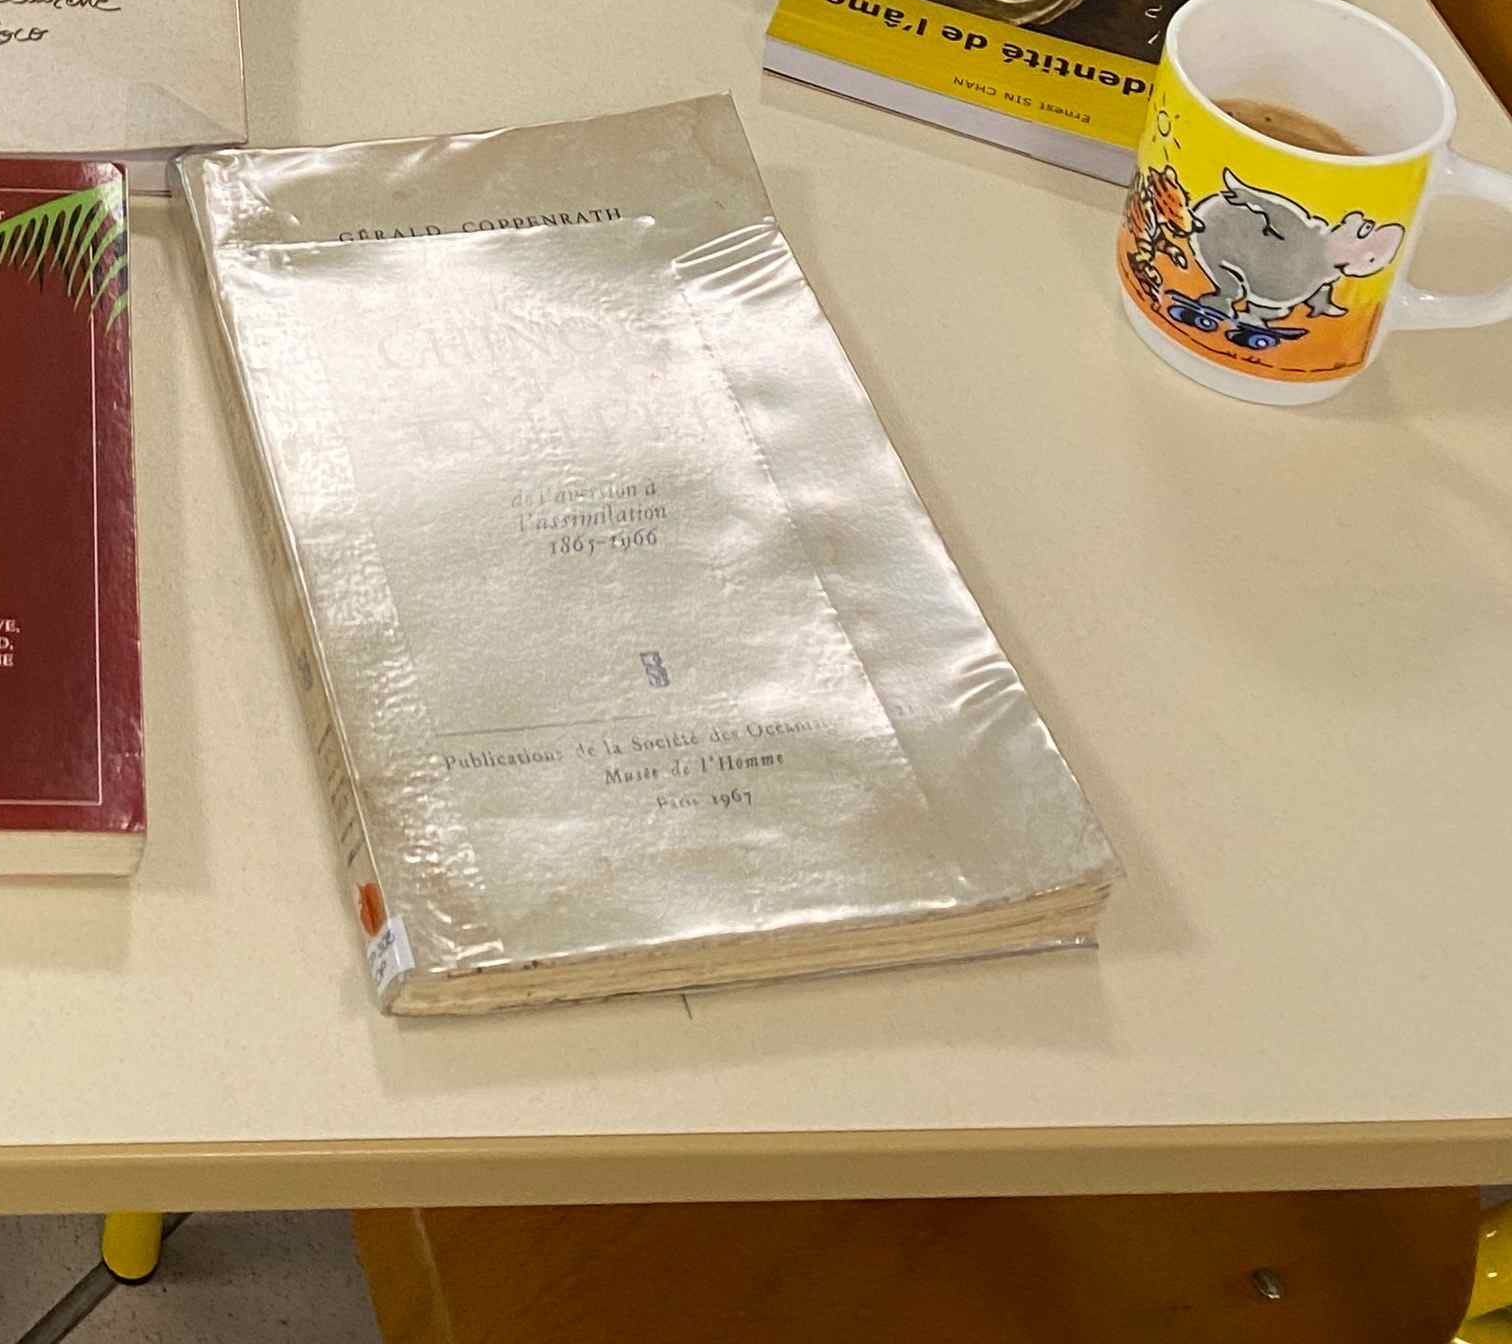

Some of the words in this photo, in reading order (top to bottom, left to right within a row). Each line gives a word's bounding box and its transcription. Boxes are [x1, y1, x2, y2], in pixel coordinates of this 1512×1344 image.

[940, 23, 988, 50] de
[953, 76, 998, 98] CHAN
[1005, 91, 1033, 106] SIN
[1039, 103, 1092, 125] Ernest
[460, 207, 623, 235] COPPENRATH
[699, 751, 786, 774] l'Homme
[711, 791, 754, 808] 1967
